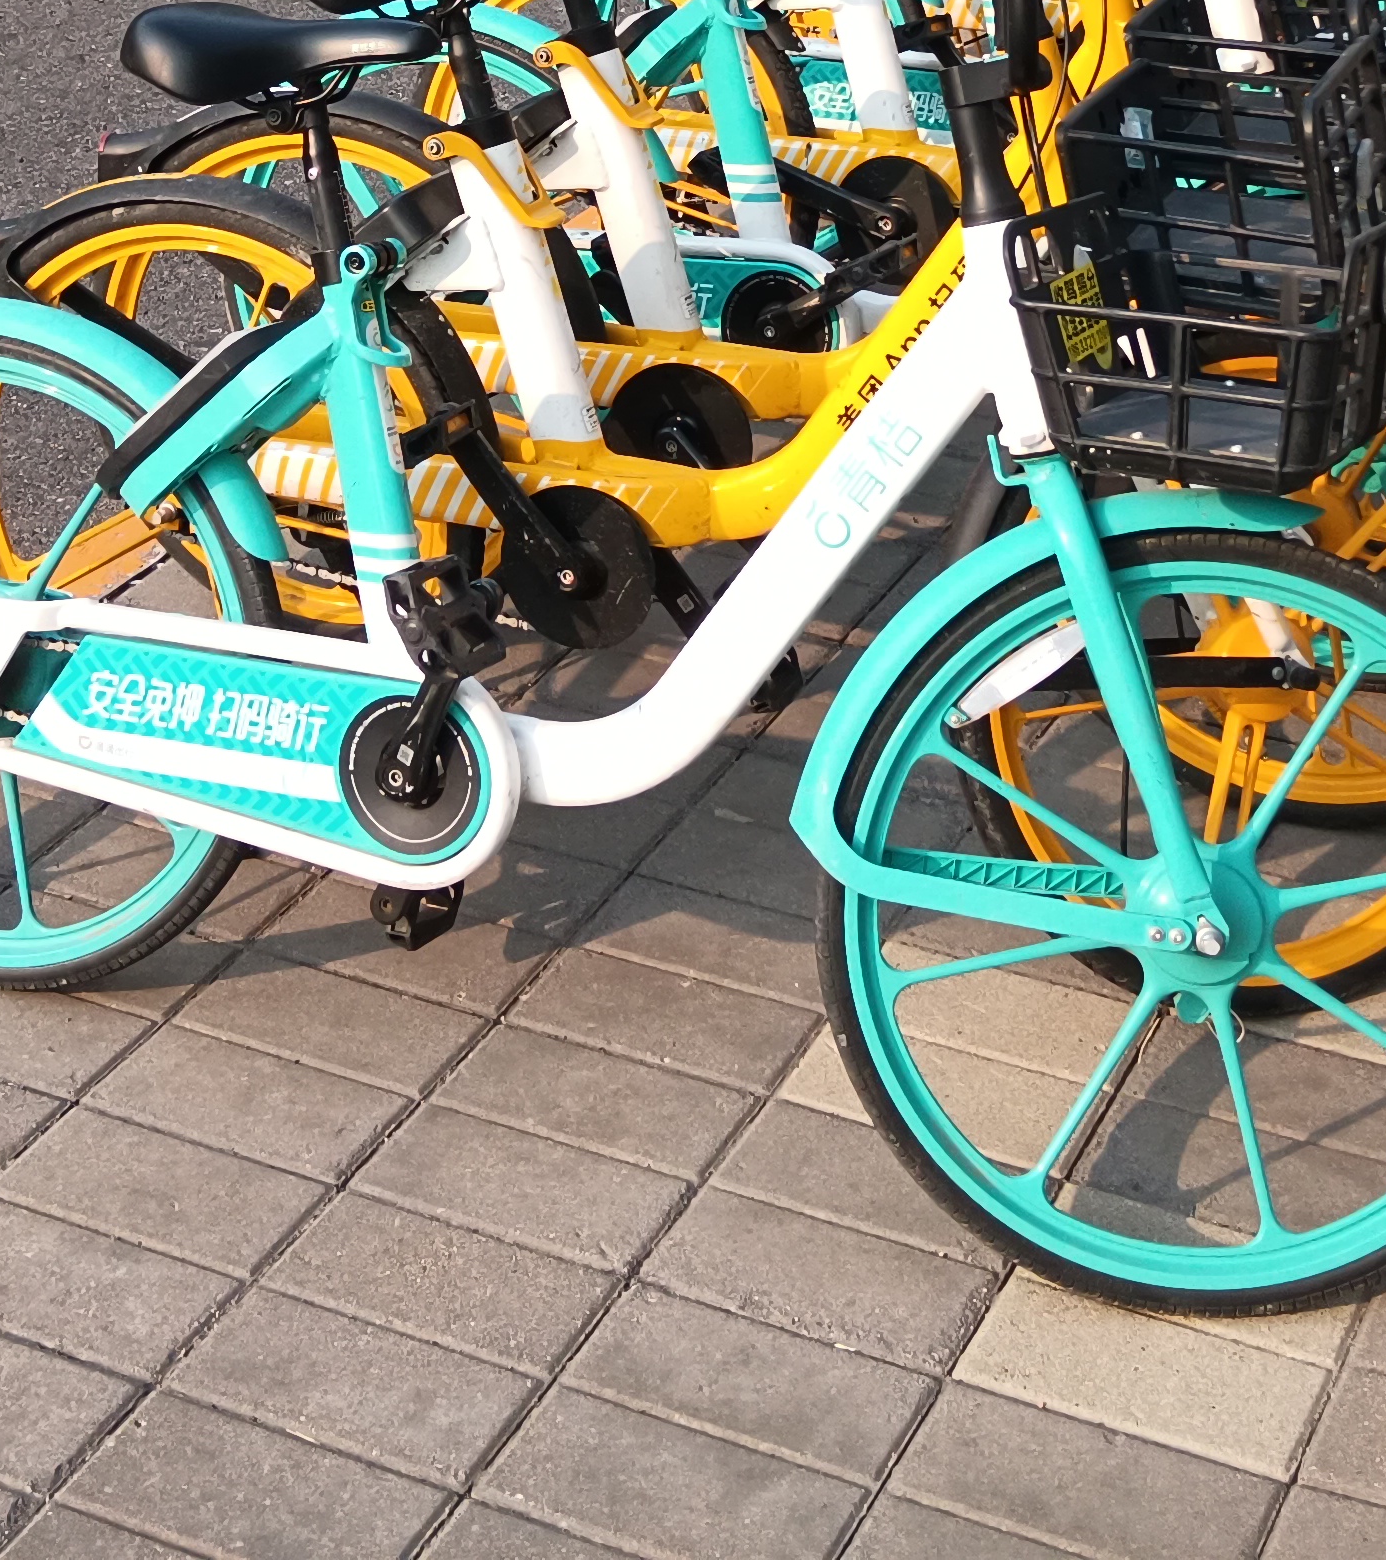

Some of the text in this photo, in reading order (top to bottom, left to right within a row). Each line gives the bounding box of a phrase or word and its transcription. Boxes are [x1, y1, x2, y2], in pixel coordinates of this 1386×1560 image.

[81, 669, 331, 753] 安全免押 扫码骑行
